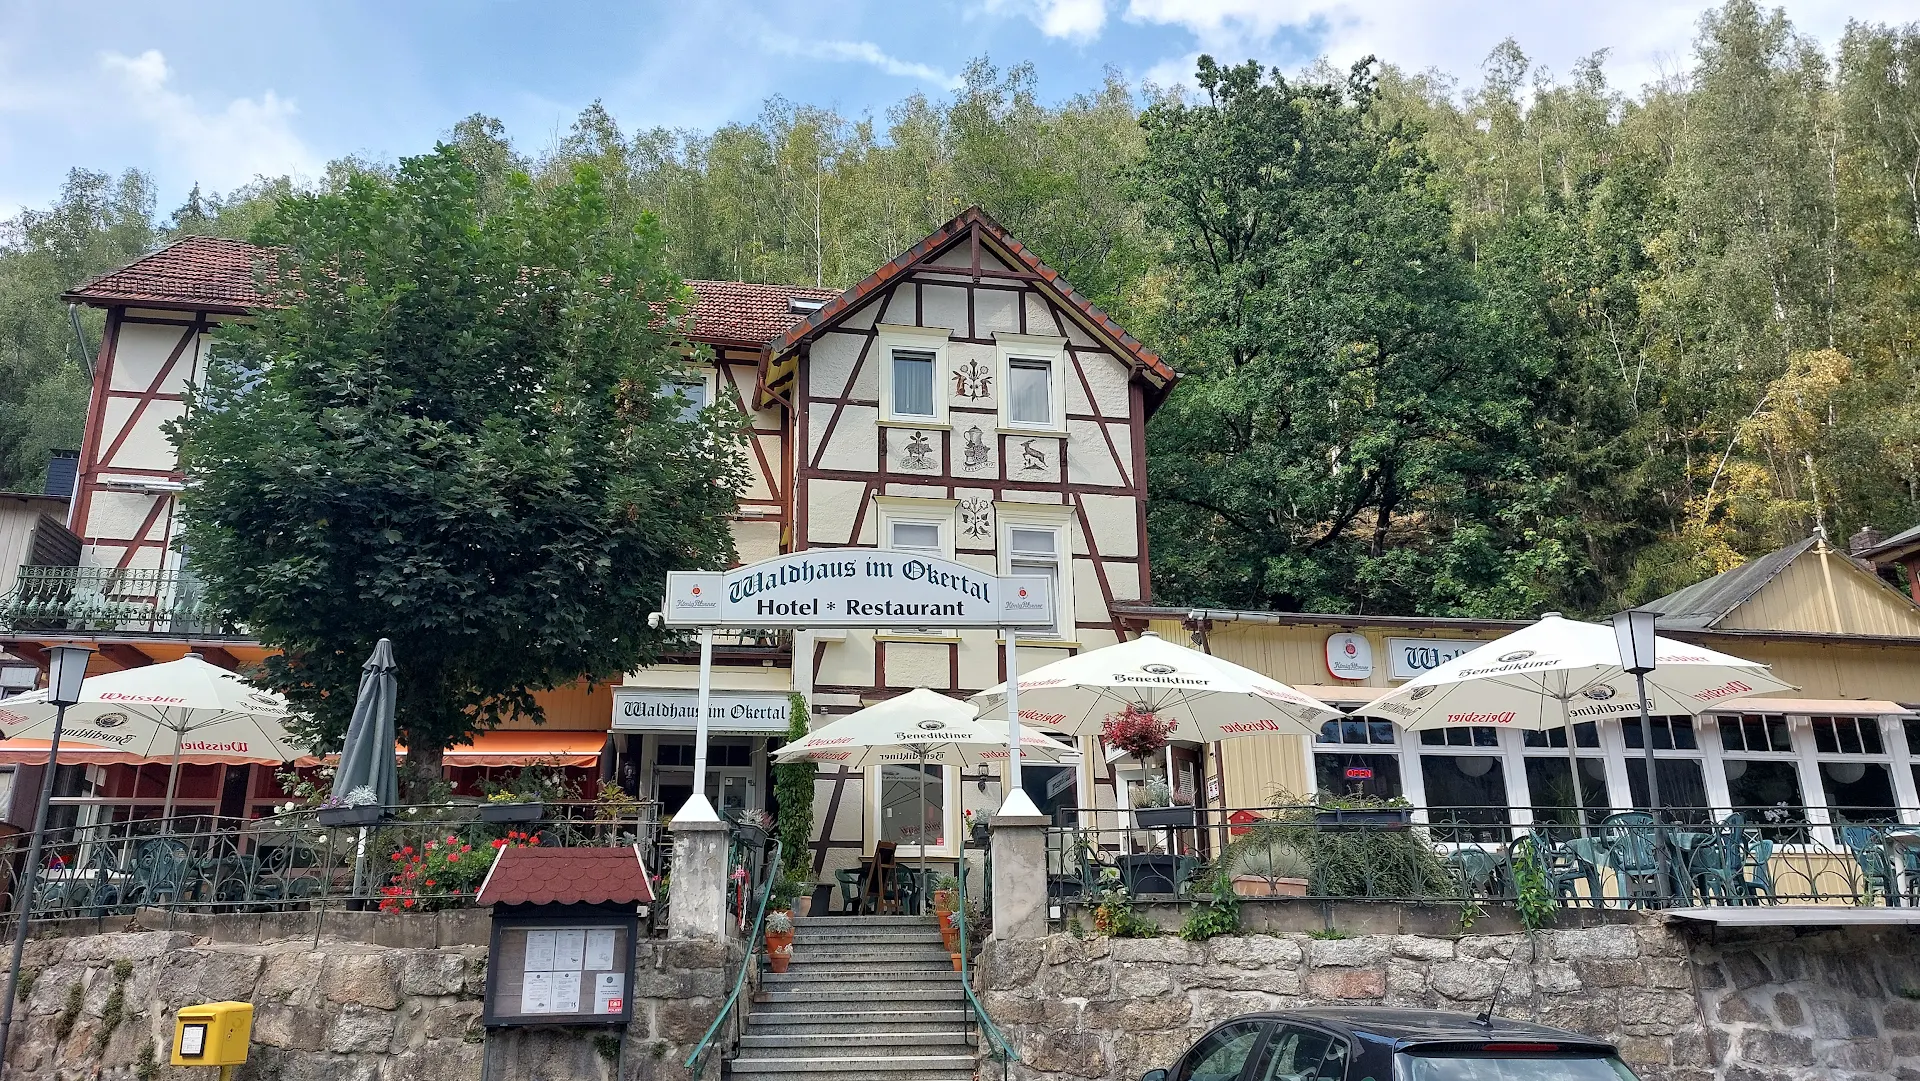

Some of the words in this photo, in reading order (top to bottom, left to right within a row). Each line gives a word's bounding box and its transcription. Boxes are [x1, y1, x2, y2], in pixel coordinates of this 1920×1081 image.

[728, 558, 857, 604] Waldhaus
[866, 557, 894, 578] im
[902, 559, 990, 604] Okertal
[757, 598, 818, 616] Hotel
[846, 599, 966, 616] Restaurant
[1458, 659, 1563, 679] Benediktiner
[1112, 673, 1211, 686] Benediktiner
[99, 692, 188, 704] Weissbier
[623, 701, 699, 719] Waldhaus
[709, 703, 725, 719] im
[730, 704, 786, 720] Okertal
[894, 731, 973, 741] Benediktiner
[1346, 769, 1372, 778] OPEN
